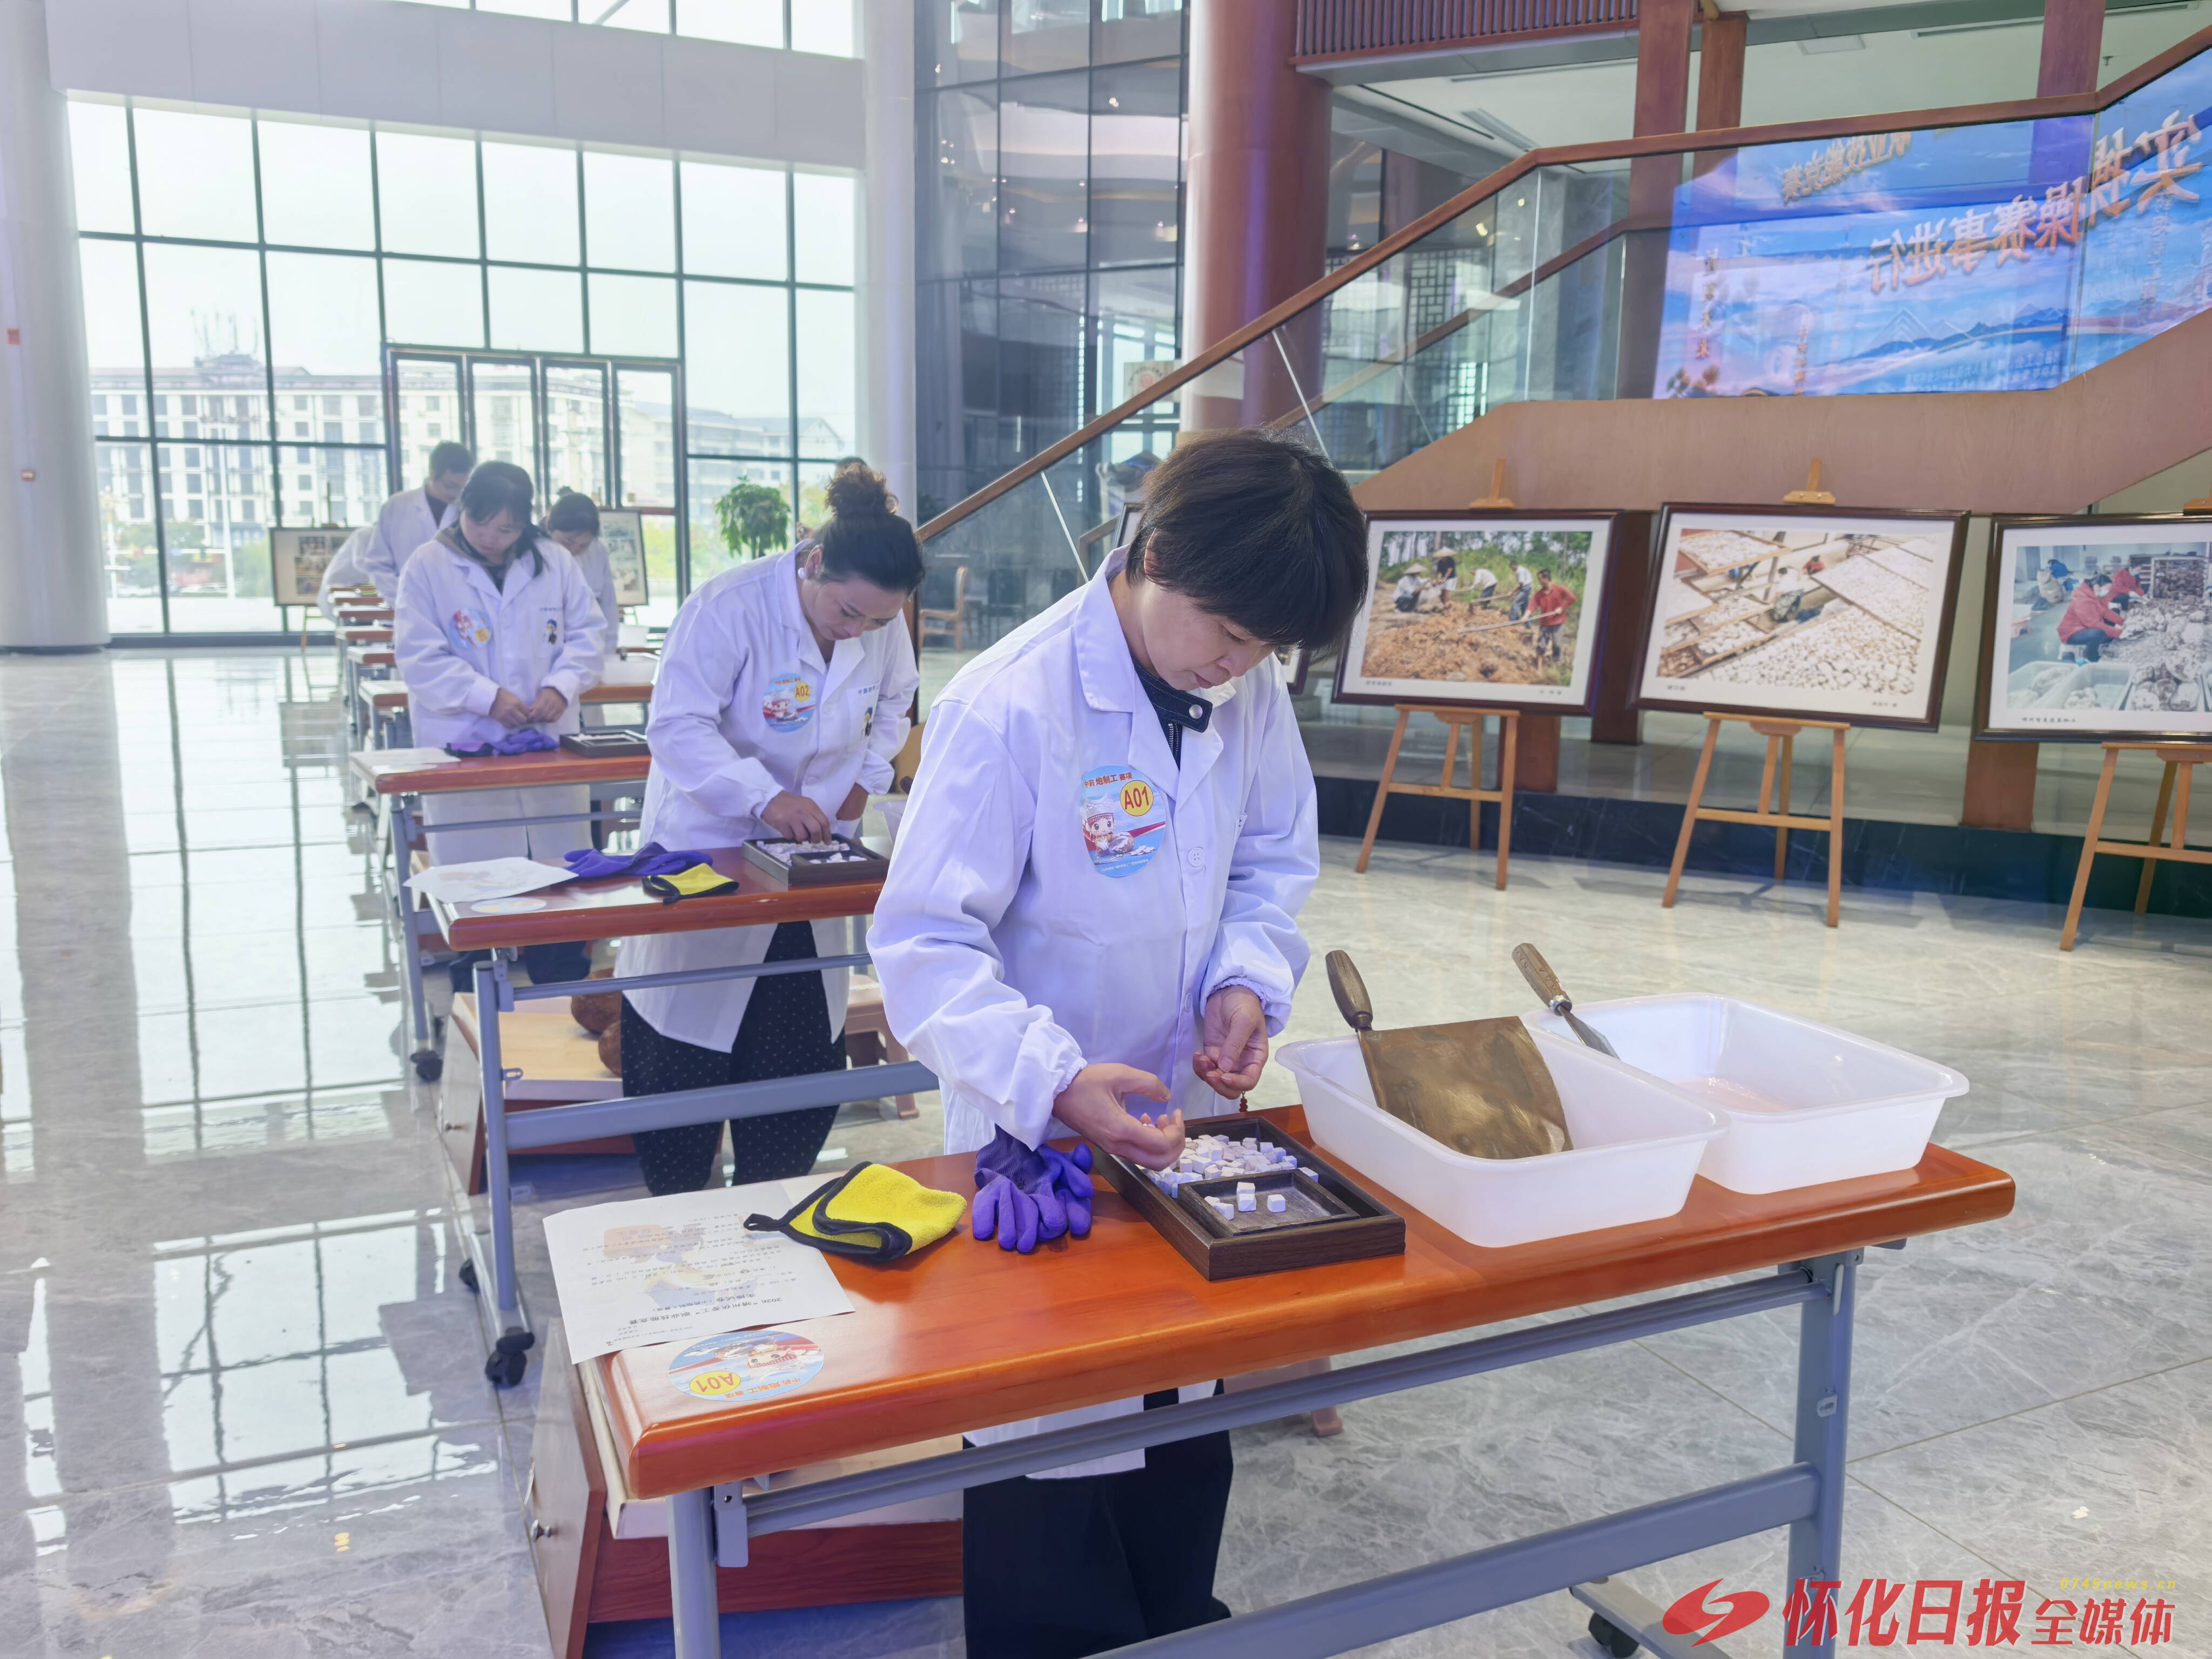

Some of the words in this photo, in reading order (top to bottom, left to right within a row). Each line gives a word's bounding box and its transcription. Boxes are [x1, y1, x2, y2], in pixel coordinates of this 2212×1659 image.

[795, 685, 810, 699] A02
[1124, 786, 1150, 810] A01
[697, 1372, 735, 1393] A01
